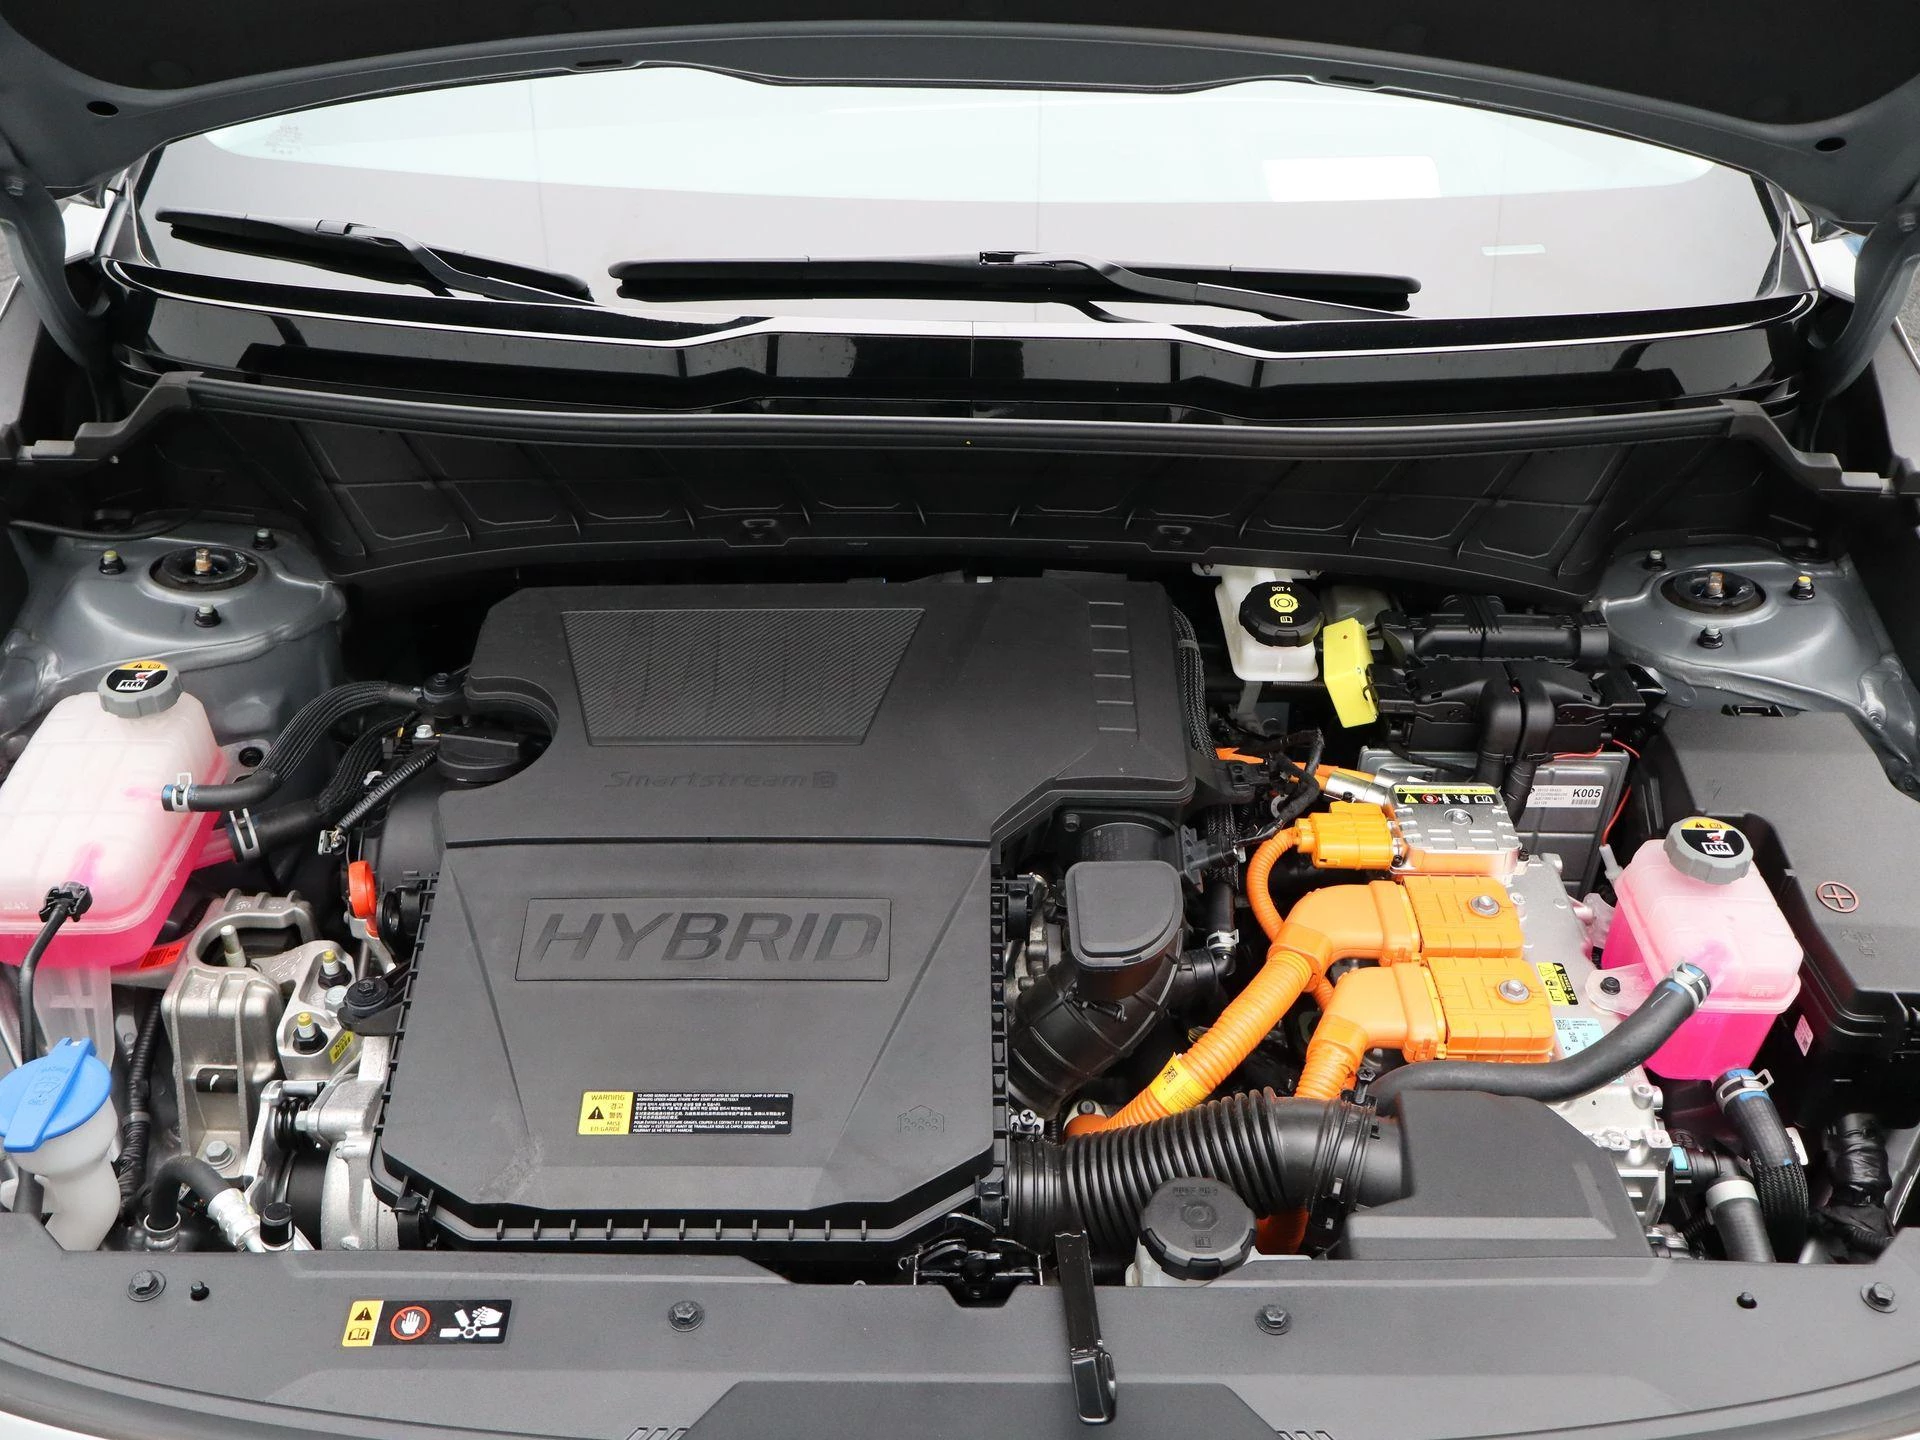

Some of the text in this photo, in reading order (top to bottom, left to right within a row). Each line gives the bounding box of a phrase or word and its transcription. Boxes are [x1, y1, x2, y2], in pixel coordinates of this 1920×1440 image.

[604, 771, 807, 788] Smartstream
[1572, 788, 1602, 798] K005
[532, 912, 883, 962] HYBRID
